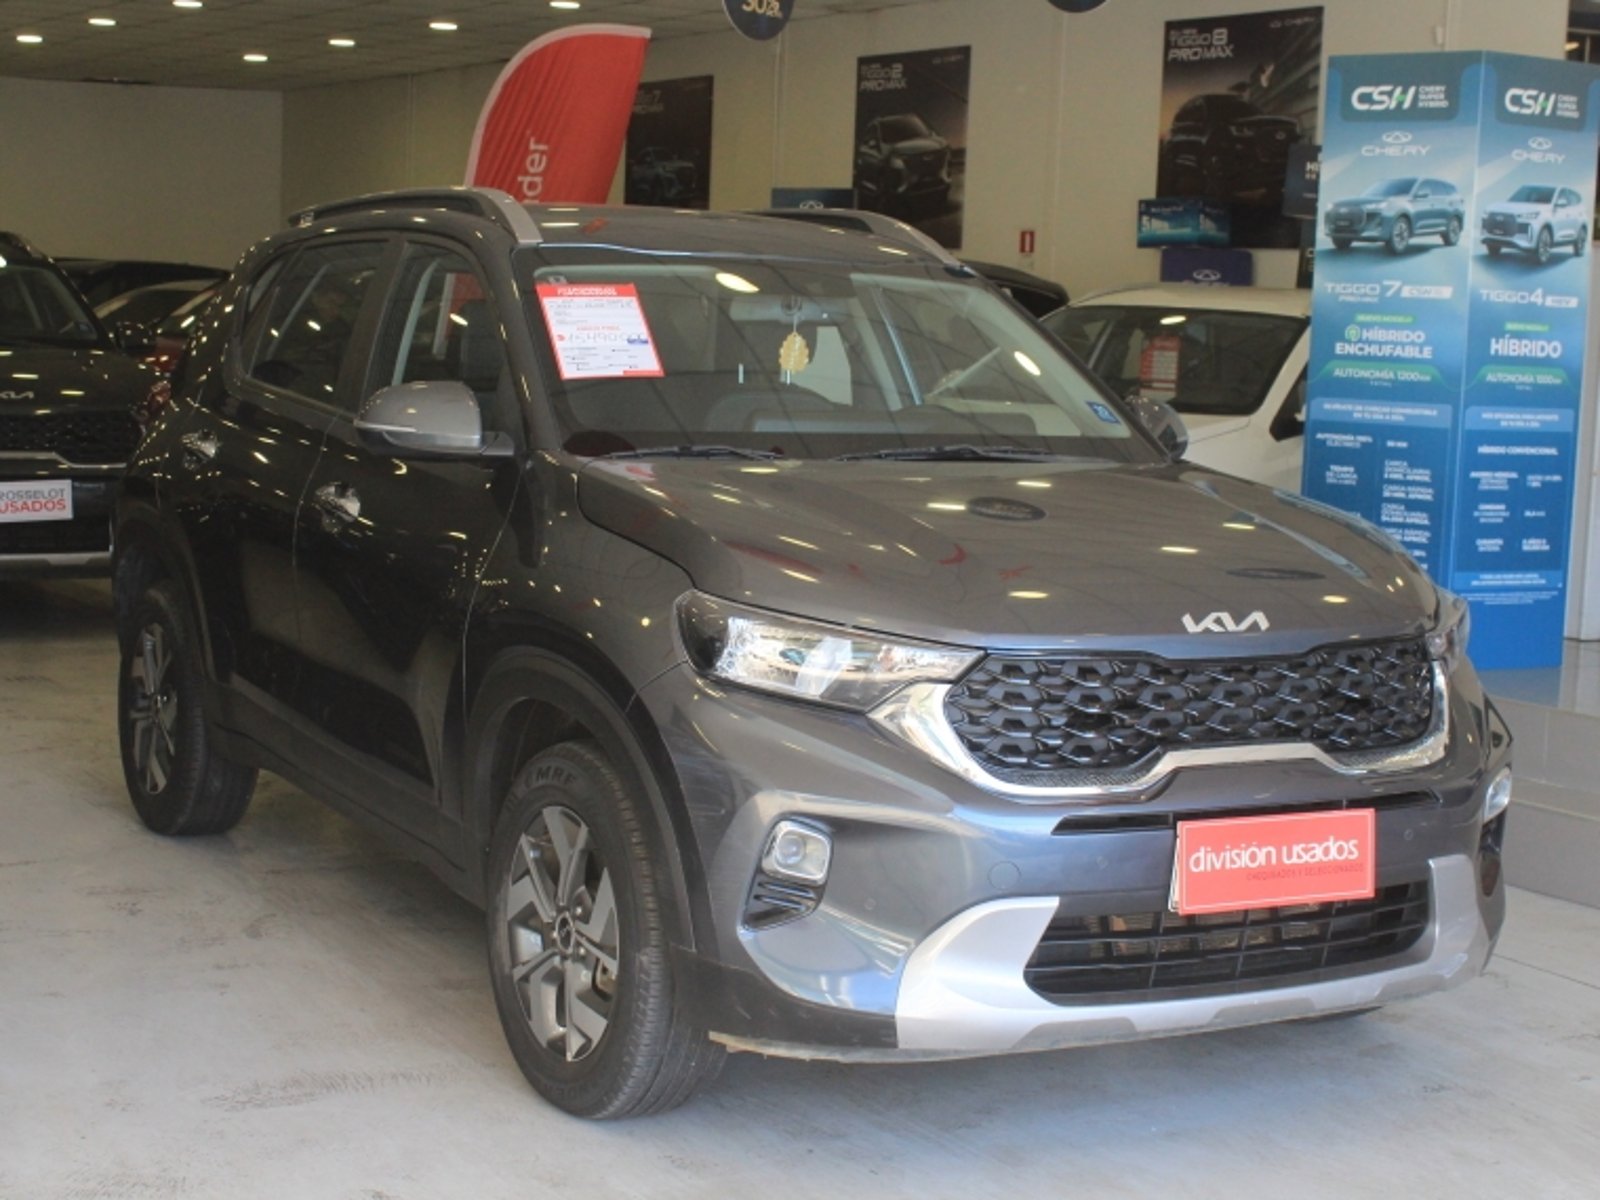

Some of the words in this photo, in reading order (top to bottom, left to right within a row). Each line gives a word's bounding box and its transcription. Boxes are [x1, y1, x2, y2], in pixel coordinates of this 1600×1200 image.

[1169, 33, 1211, 46] TIGGO
[1212, 28, 1228, 45] 8
[1351, 85, 1417, 110] CSH
[1505, 87, 1556, 116] CSH
[1361, 145, 1431, 156] CHERY
[1511, 148, 1566, 164] CHERY
[1324, 282, 1380, 296] TIGGO
[1382, 279, 1402, 298] 7
[1480, 289, 1529, 304] TIGGO
[1530, 287, 1543, 306] 4
[1362, 326, 1425, 343] HÍBRIDO
[1334, 342, 1433, 359] ENCHUFABLE
[1490, 333, 1562, 358] HÍBRIDO
[1333, 367, 1395, 380] AUTONOMÍA
[1181, 610, 1270, 632] KIA
[1188, 841, 1277, 873] división
[1281, 836, 1359, 865] usados
